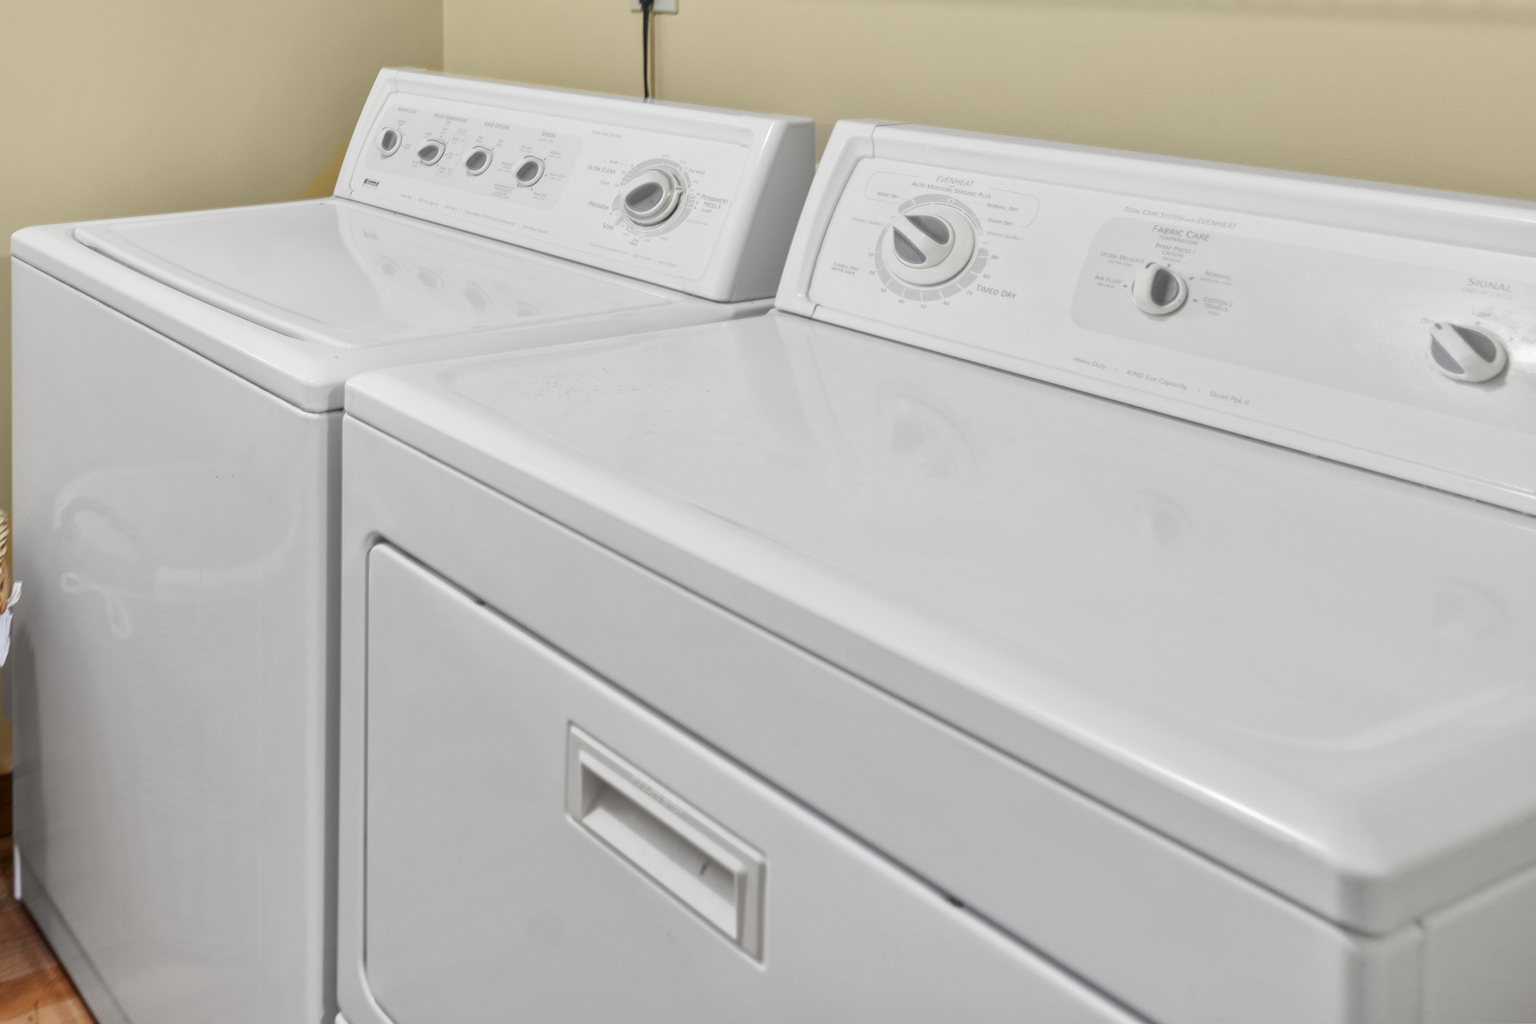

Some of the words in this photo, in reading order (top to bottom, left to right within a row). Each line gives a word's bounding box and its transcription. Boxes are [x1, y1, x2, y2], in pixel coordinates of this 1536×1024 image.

[936, 176, 974, 187] EVENHEAT
[927, 184, 953, 193] MOISTURE
[954, 188, 977, 197] SENSING
[700, 193, 729, 204] PERMANENT
[588, 201, 609, 210] PREWASH
[986, 202, 1007, 211] NORMAL
[1124, 205, 1141, 215] TOTAL
[1142, 209, 1159, 218] CARE
[1160, 212, 1184, 221] SYSTEM
[1196, 218, 1237, 230] EVENHEAT
[1152, 224, 1184, 237] FABRIC
[1186, 230, 1211, 242] CARE
[1159, 235, 1199, 246] TEMPERATURE
[1161, 250, 1184, 258] CASUAL
[1173, 246, 1192, 254] PRESS
[1100, 251, 1118, 260] ULTRA
[1119, 254, 1145, 264] DELICATE
[1105, 276, 1122, 284] FLUFF
[1205, 271, 1231, 280] NORMAL
[1467, 277, 1513, 293] SIGNAL
[976, 284, 1000, 296] TIMED
[1000, 290, 1017, 299] DRY
[1203, 296, 1228, 306] COTTON
[1203, 302, 1228, 312] TOWELS
[1072, 356, 1091, 366] Heavy
[1092, 360, 1107, 370] Duty
[1144, 374, 1158, 382] Size
[1158, 378, 1188, 391] Capacity
[1209, 390, 1229, 400] Quiet
[1230, 395, 1242, 404] Pak
